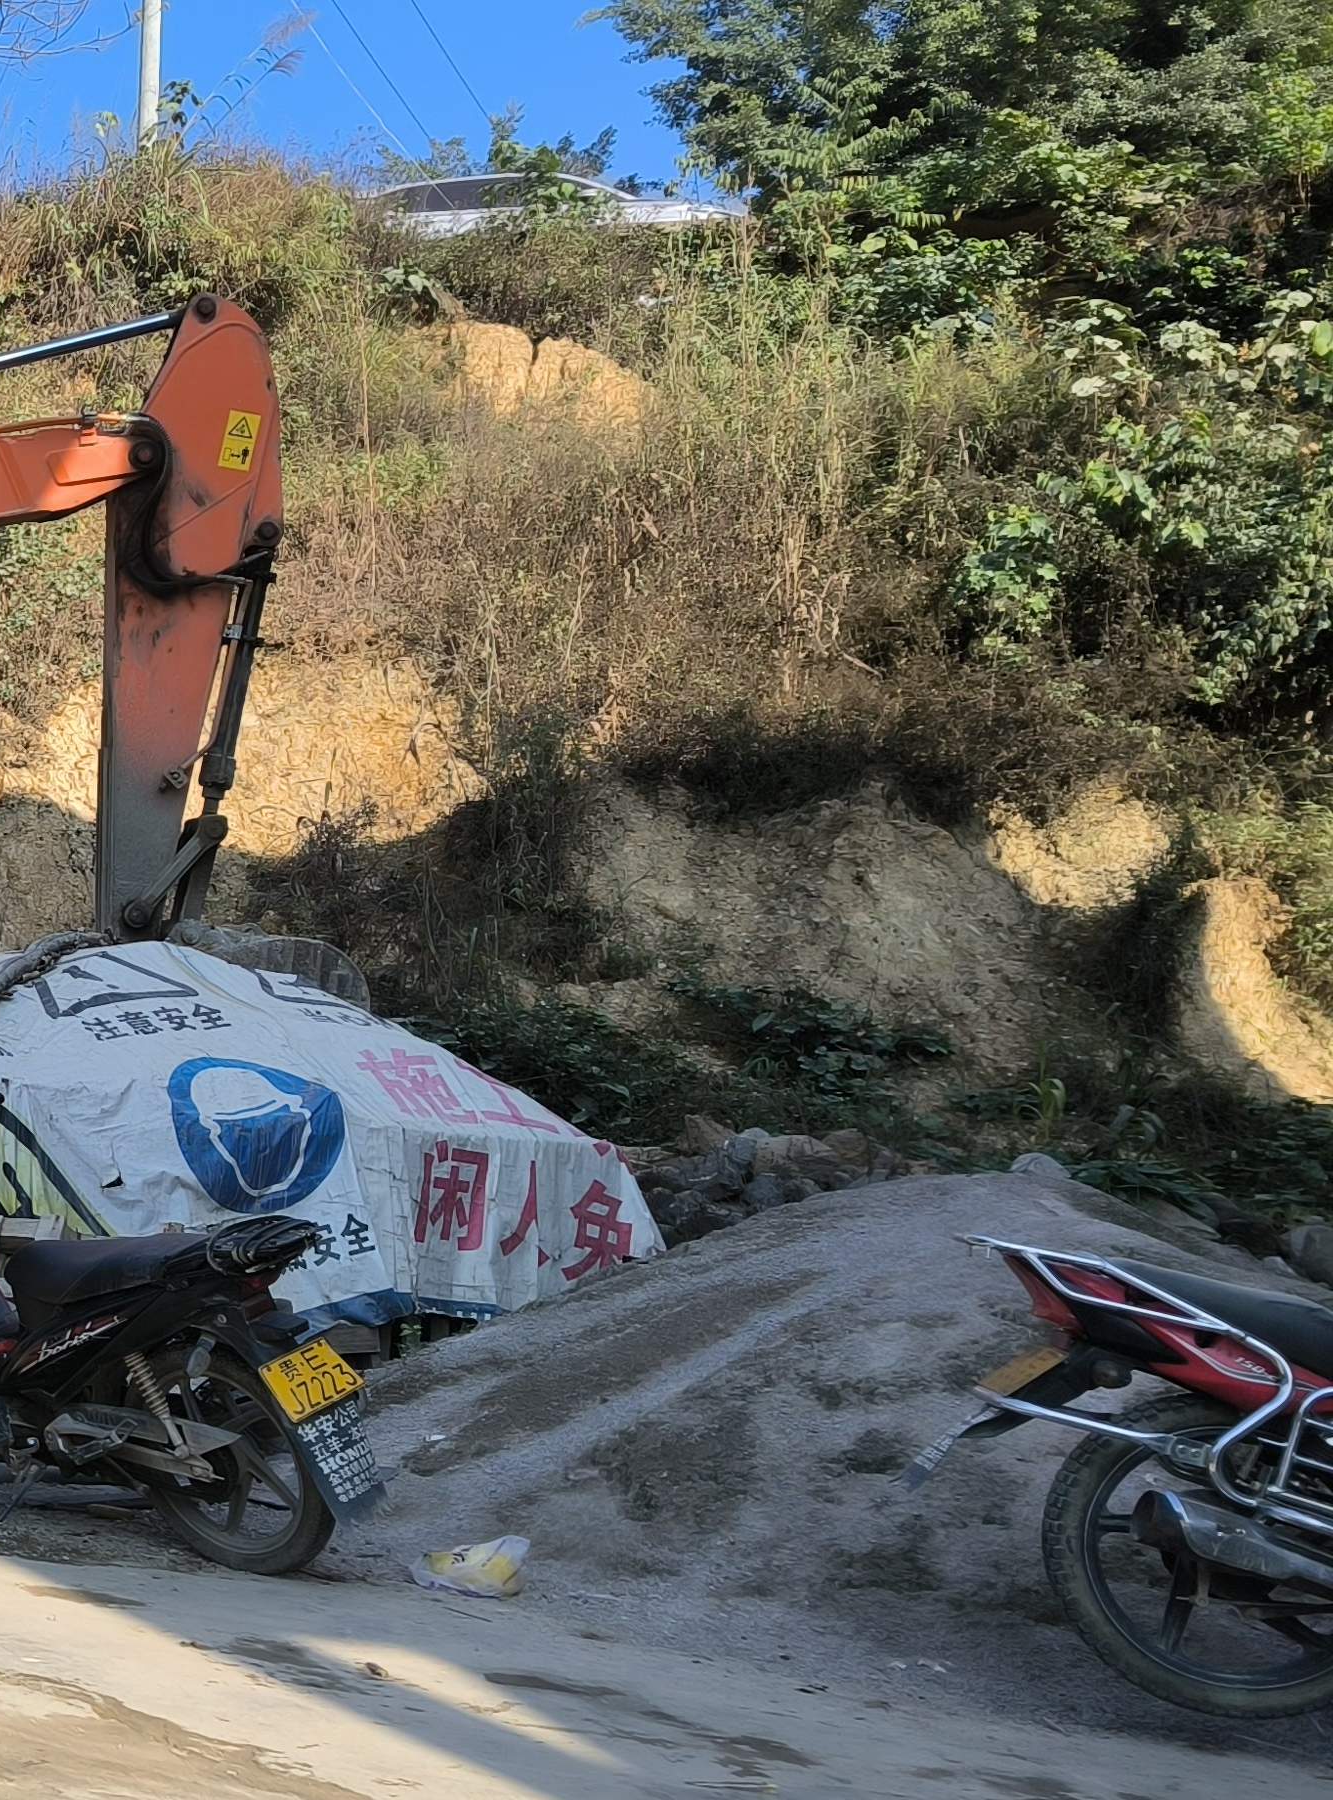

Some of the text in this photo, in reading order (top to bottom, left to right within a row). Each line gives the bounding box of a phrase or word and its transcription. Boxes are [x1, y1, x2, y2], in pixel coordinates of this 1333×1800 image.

[81, 1002, 232, 1042] 注意安全
[413, 1139, 633, 1282] 闲人免
[292, 1363, 358, 1415] JZ223
[297, 1400, 359, 1443] 华安公司
